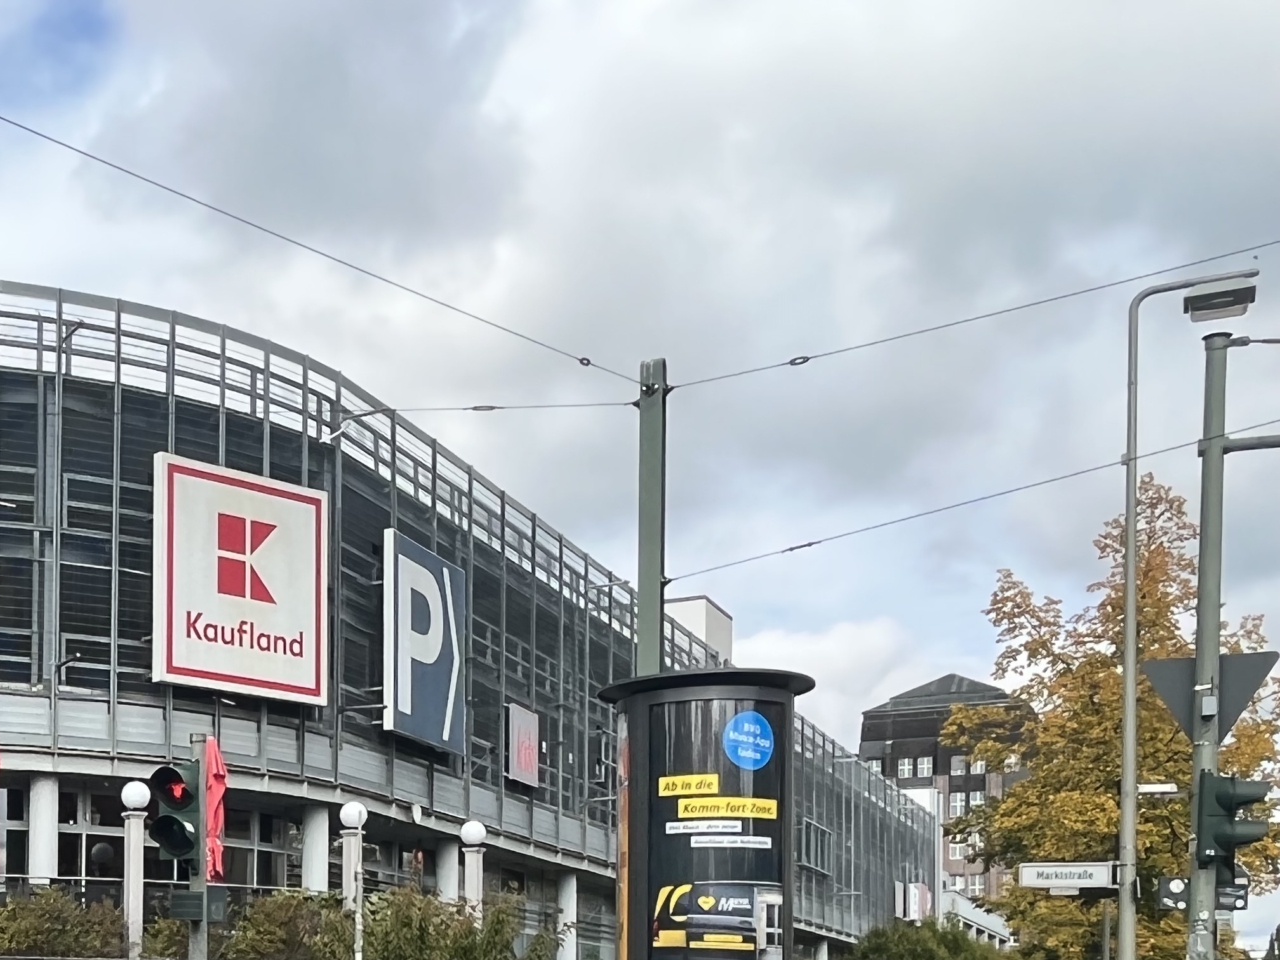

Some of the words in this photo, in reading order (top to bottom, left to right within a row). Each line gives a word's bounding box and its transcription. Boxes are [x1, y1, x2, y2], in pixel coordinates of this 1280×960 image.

[186, 610, 304, 658] Kaufland
[397, 554, 444, 715] P
[663, 780, 678, 792] Ab
[681, 781, 692, 791] in
[695, 779, 714, 791] die
